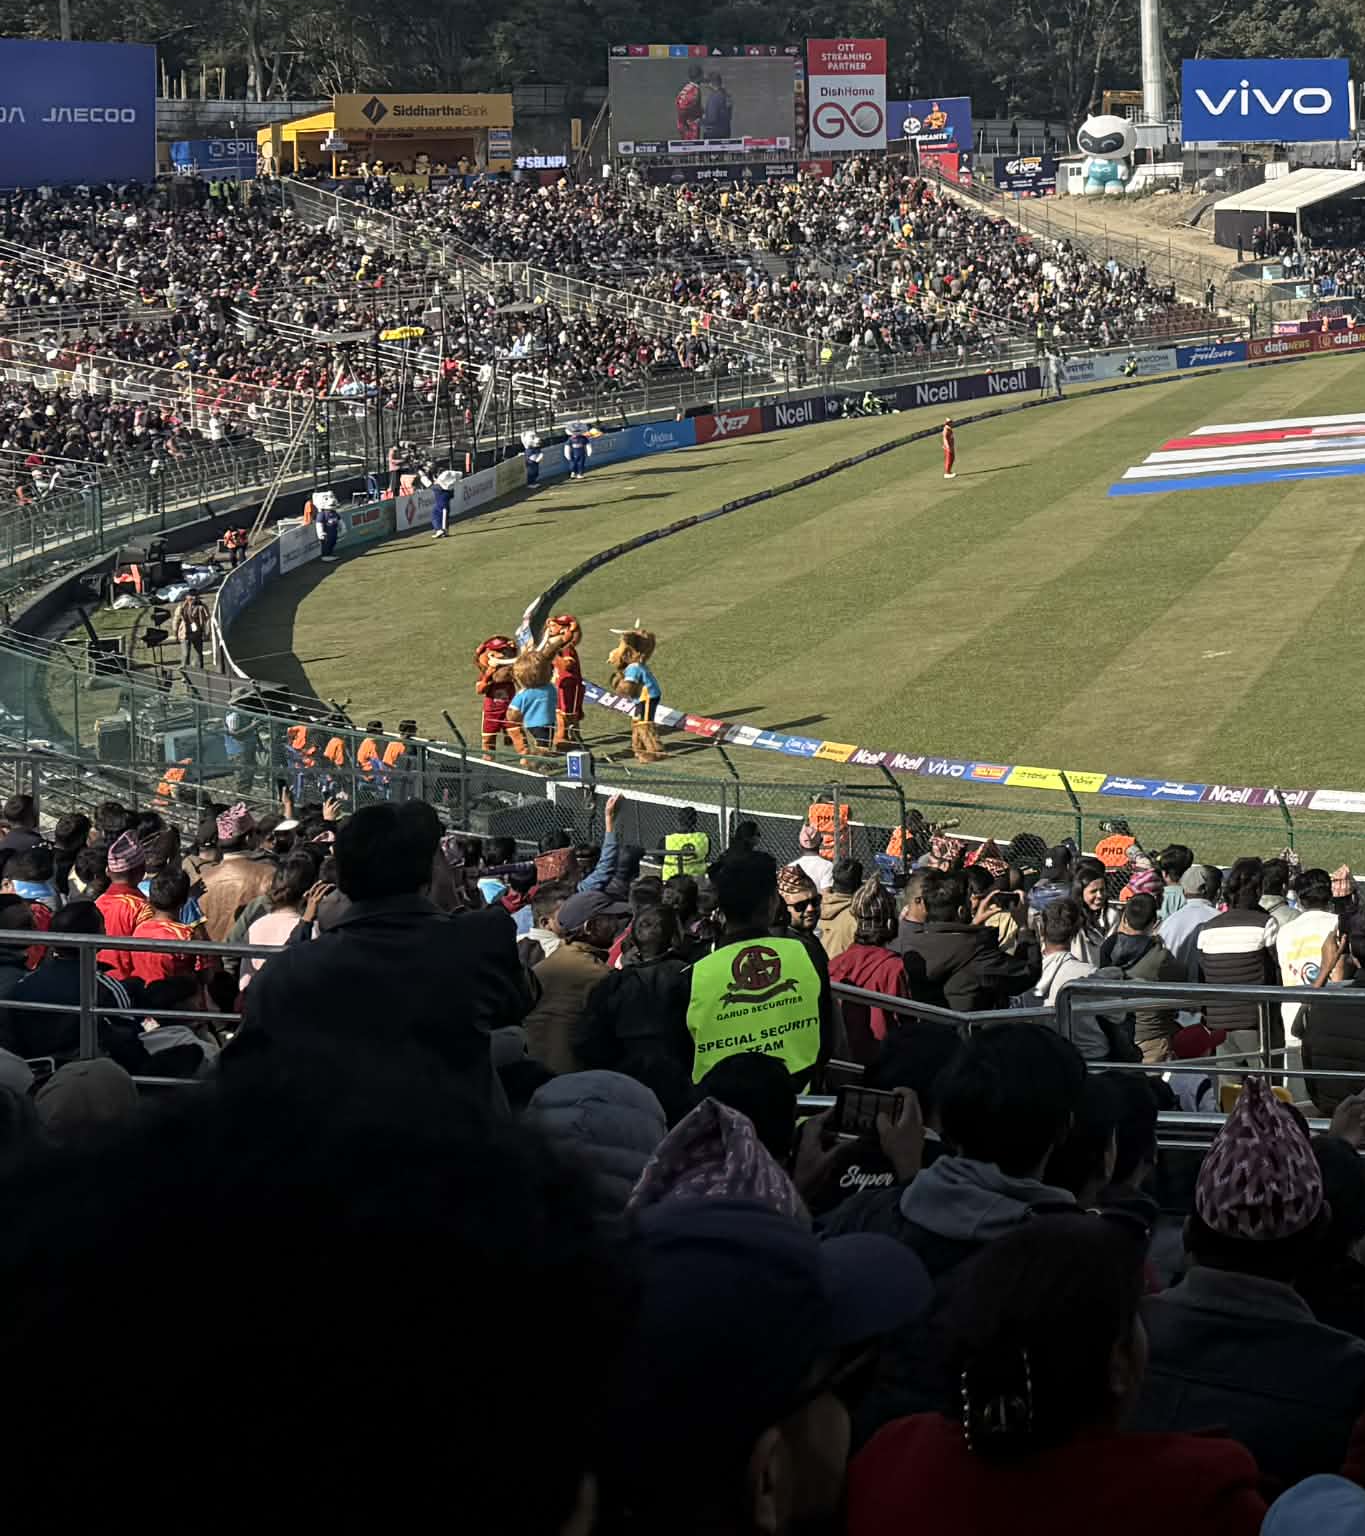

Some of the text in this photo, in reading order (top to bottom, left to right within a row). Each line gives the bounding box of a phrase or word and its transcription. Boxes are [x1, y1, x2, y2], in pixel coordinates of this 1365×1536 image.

[837, 43, 855, 52] OTT
[821, 52, 872, 62] STREAMING
[827, 61, 866, 71] PARTNER
[820, 86, 875, 97] DishHome
[1195, 79, 1333, 116] vivo
[42, 108, 136, 123] JAECOO
[393, 103, 488, 117] SiddharthaBank
[988, 370, 1027, 395] Ncell
[916, 381, 958, 405] Ncell
[775, 401, 813, 427] Ncell
[928, 760, 965, 777] vivo
[1209, 786, 1253, 804] Ncell
[716, 996, 803, 1021] GARUD SECURITIES
[698, 1017, 819, 1054] SPECIAL SECURITY
[746, 1039, 785, 1054] TEAM
